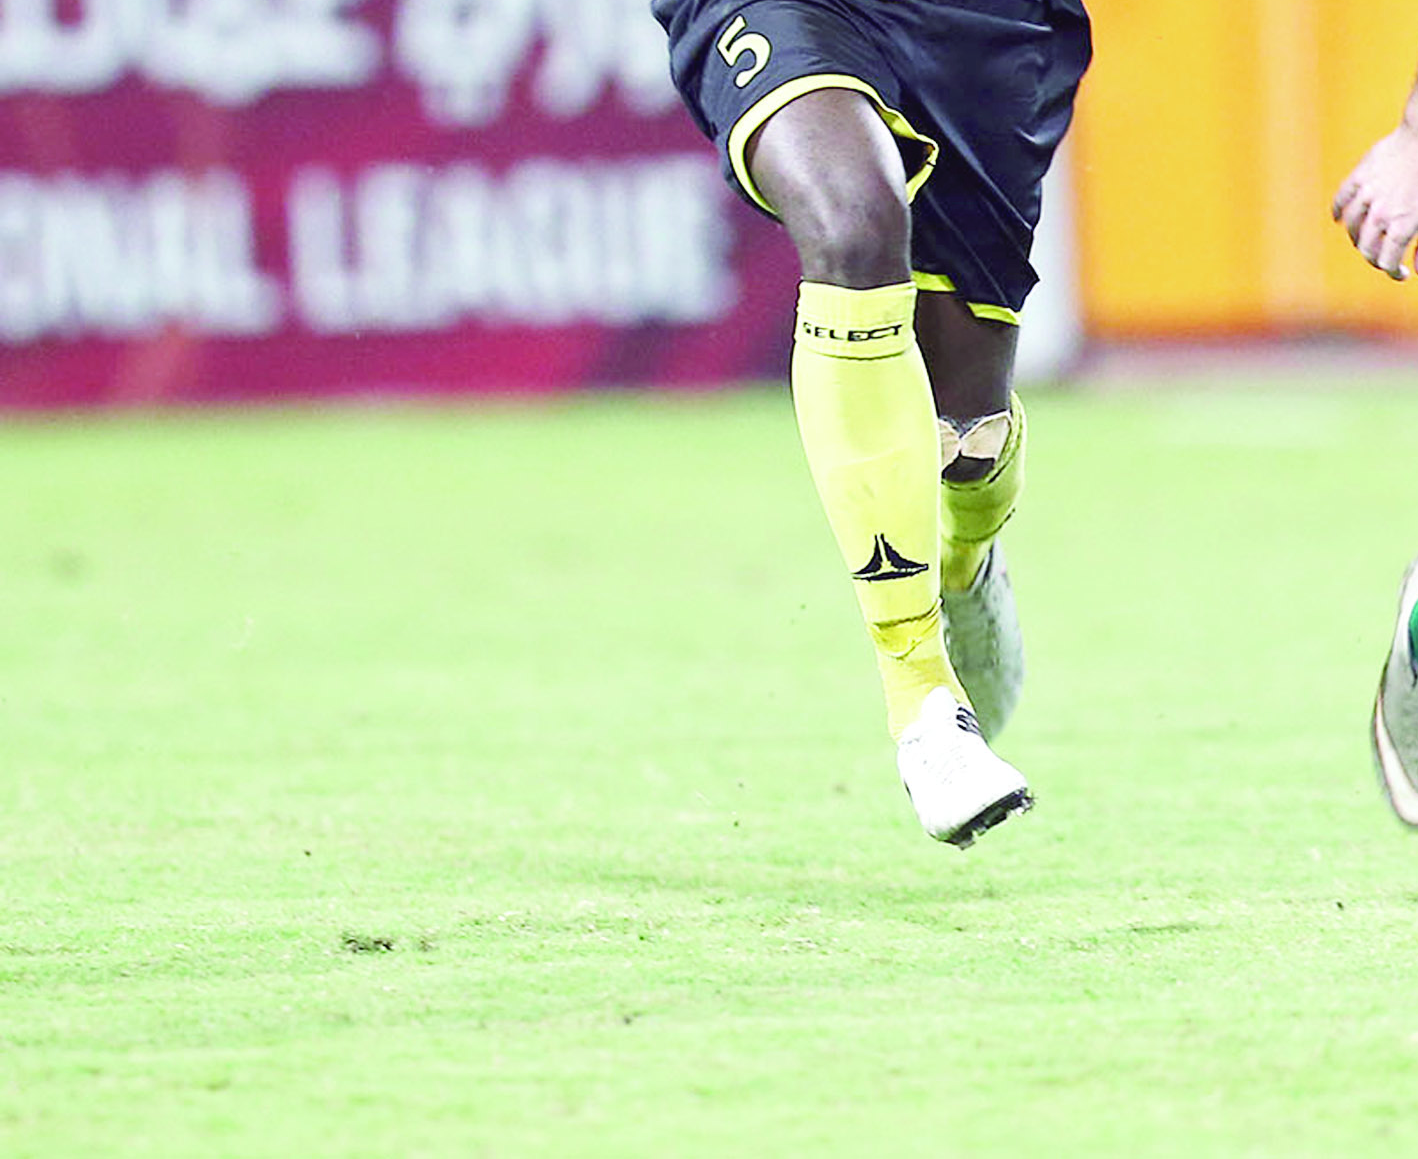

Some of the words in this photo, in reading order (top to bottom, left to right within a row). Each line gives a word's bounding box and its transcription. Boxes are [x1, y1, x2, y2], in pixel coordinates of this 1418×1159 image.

[716, 13, 773, 89] 5
[292, 157, 732, 331] LEAGUE
[802, 321, 903, 342] SELECT
